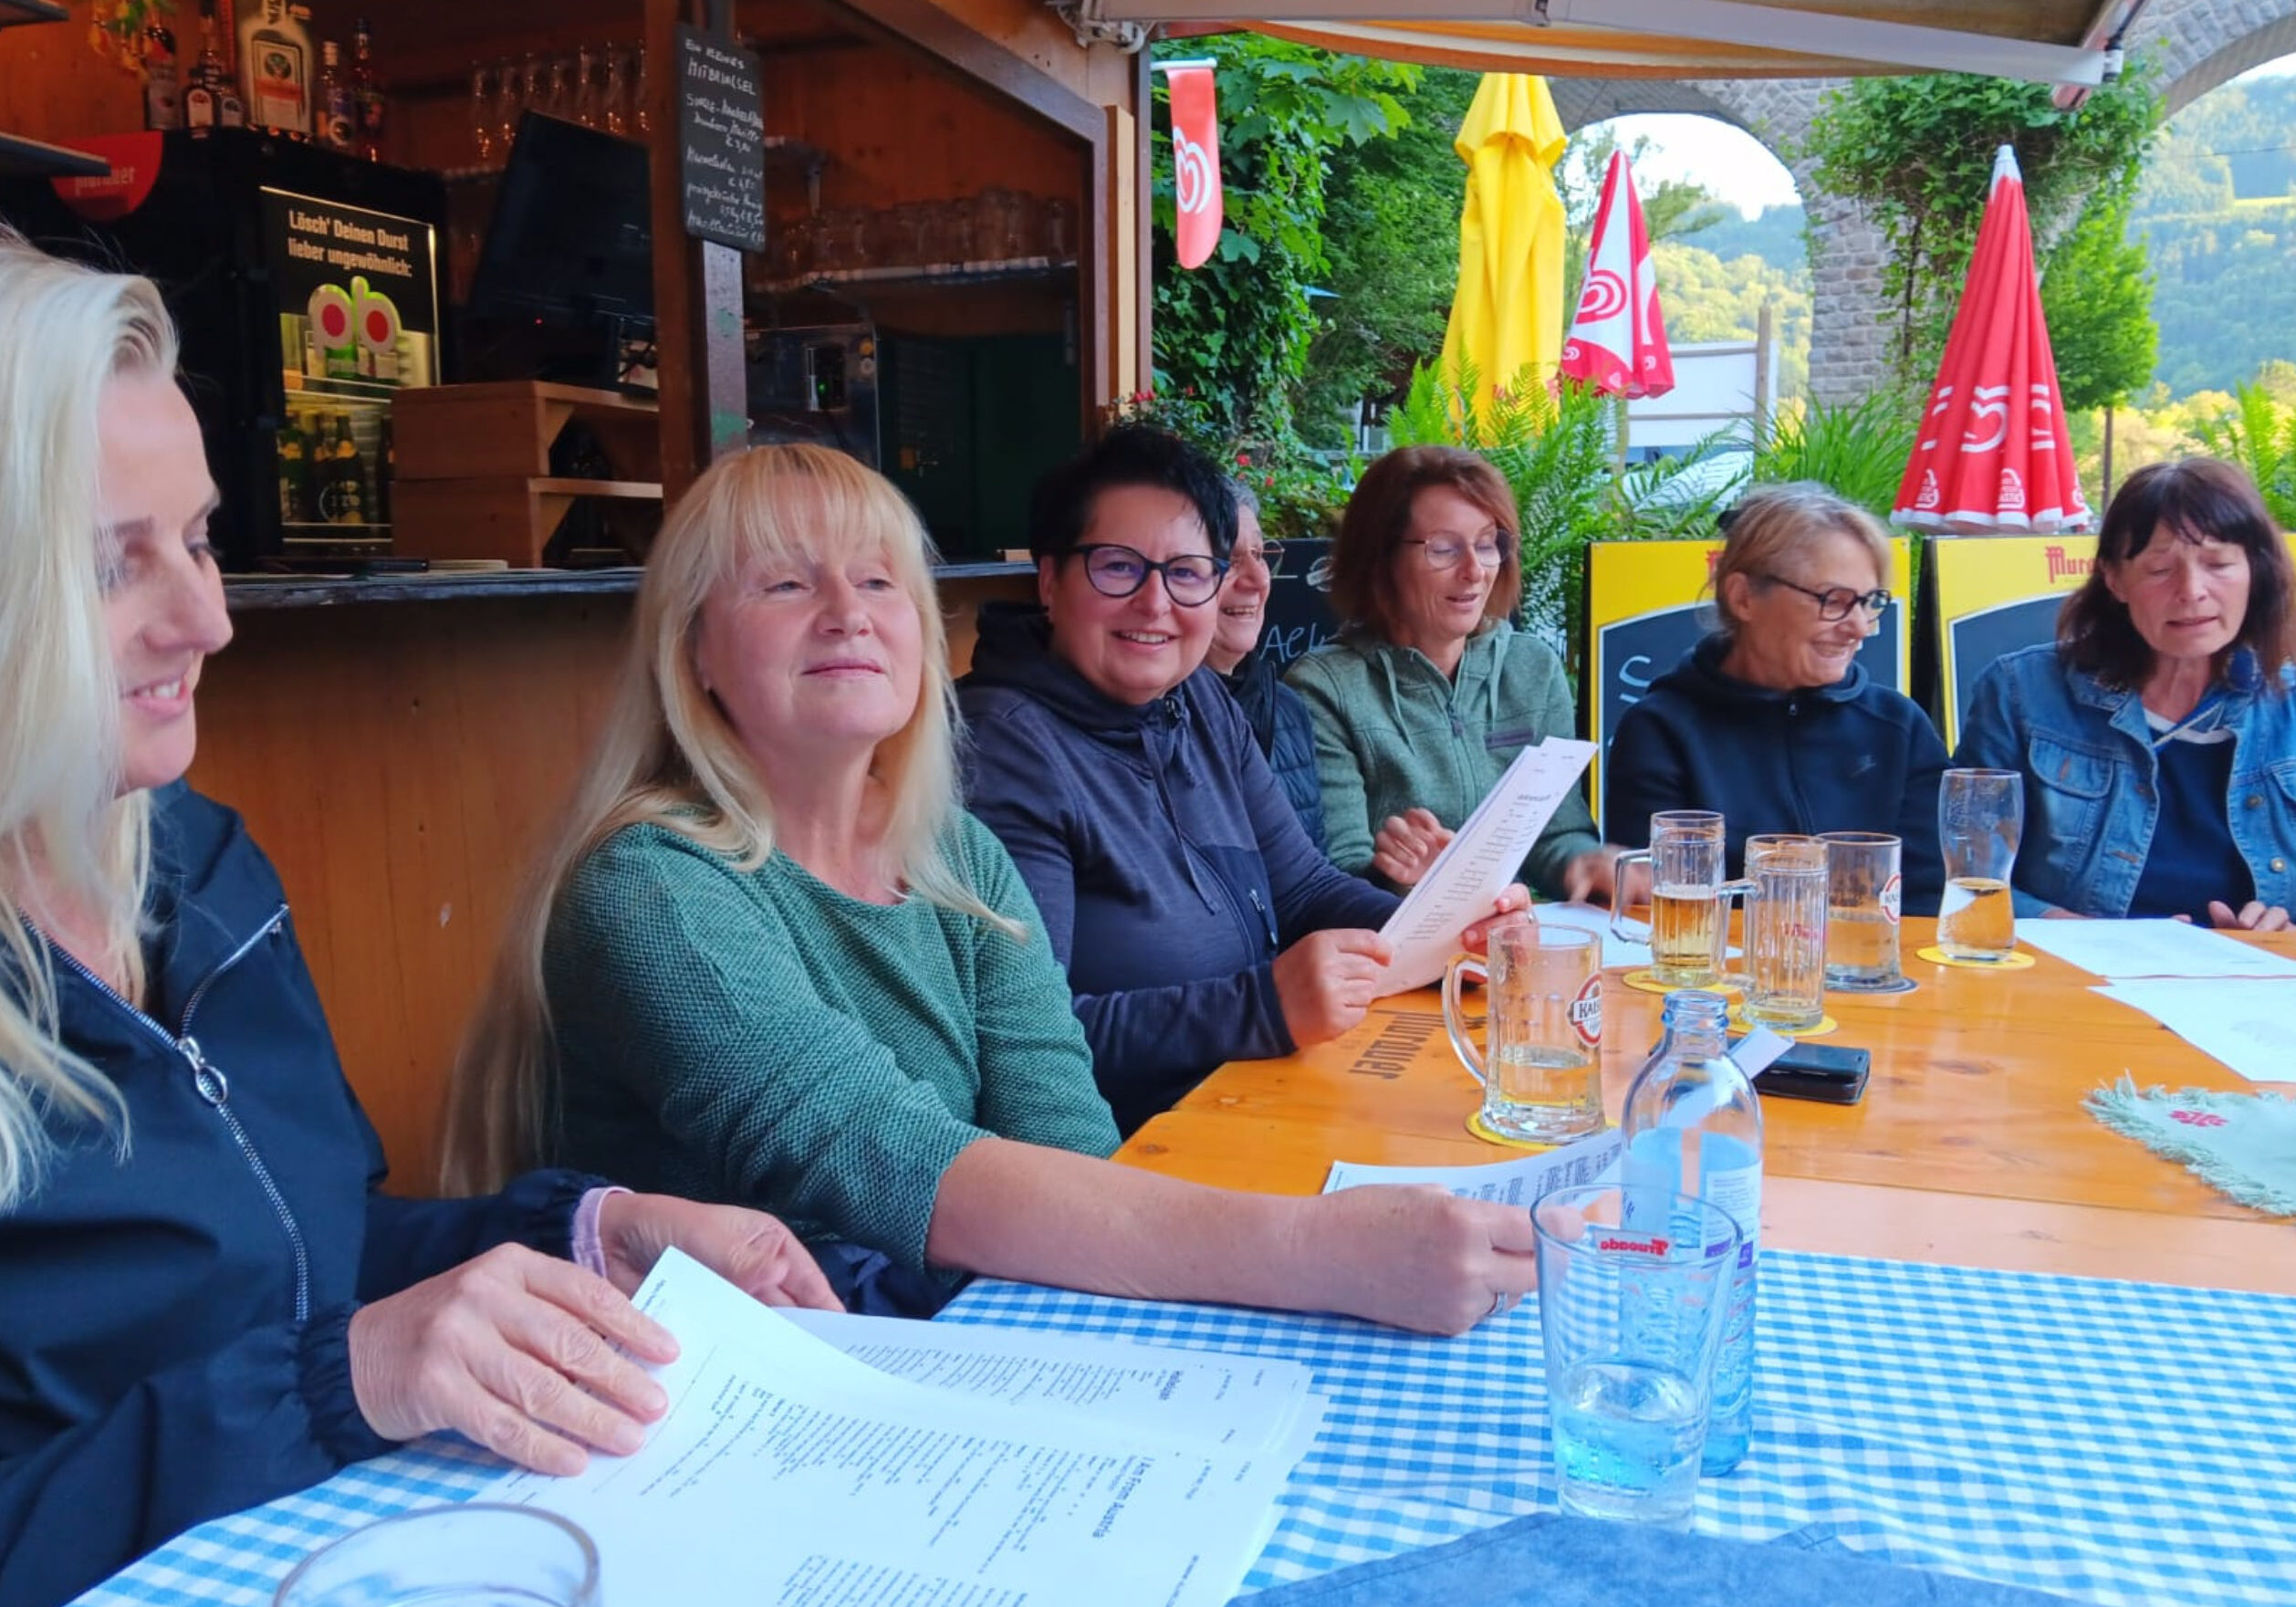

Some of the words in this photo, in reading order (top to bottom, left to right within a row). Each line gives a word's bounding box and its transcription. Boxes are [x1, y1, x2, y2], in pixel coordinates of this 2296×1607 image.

[288, 210, 331, 235] Lösch'
[333, 218, 376, 245] Deinen
[377, 227, 410, 252] Durst
[287, 236, 325, 262] lieber
[1132, 1462, 1151, 1476] Am
[1115, 1477, 1142, 1501] From
[1091, 1502, 1125, 1539] Austria
